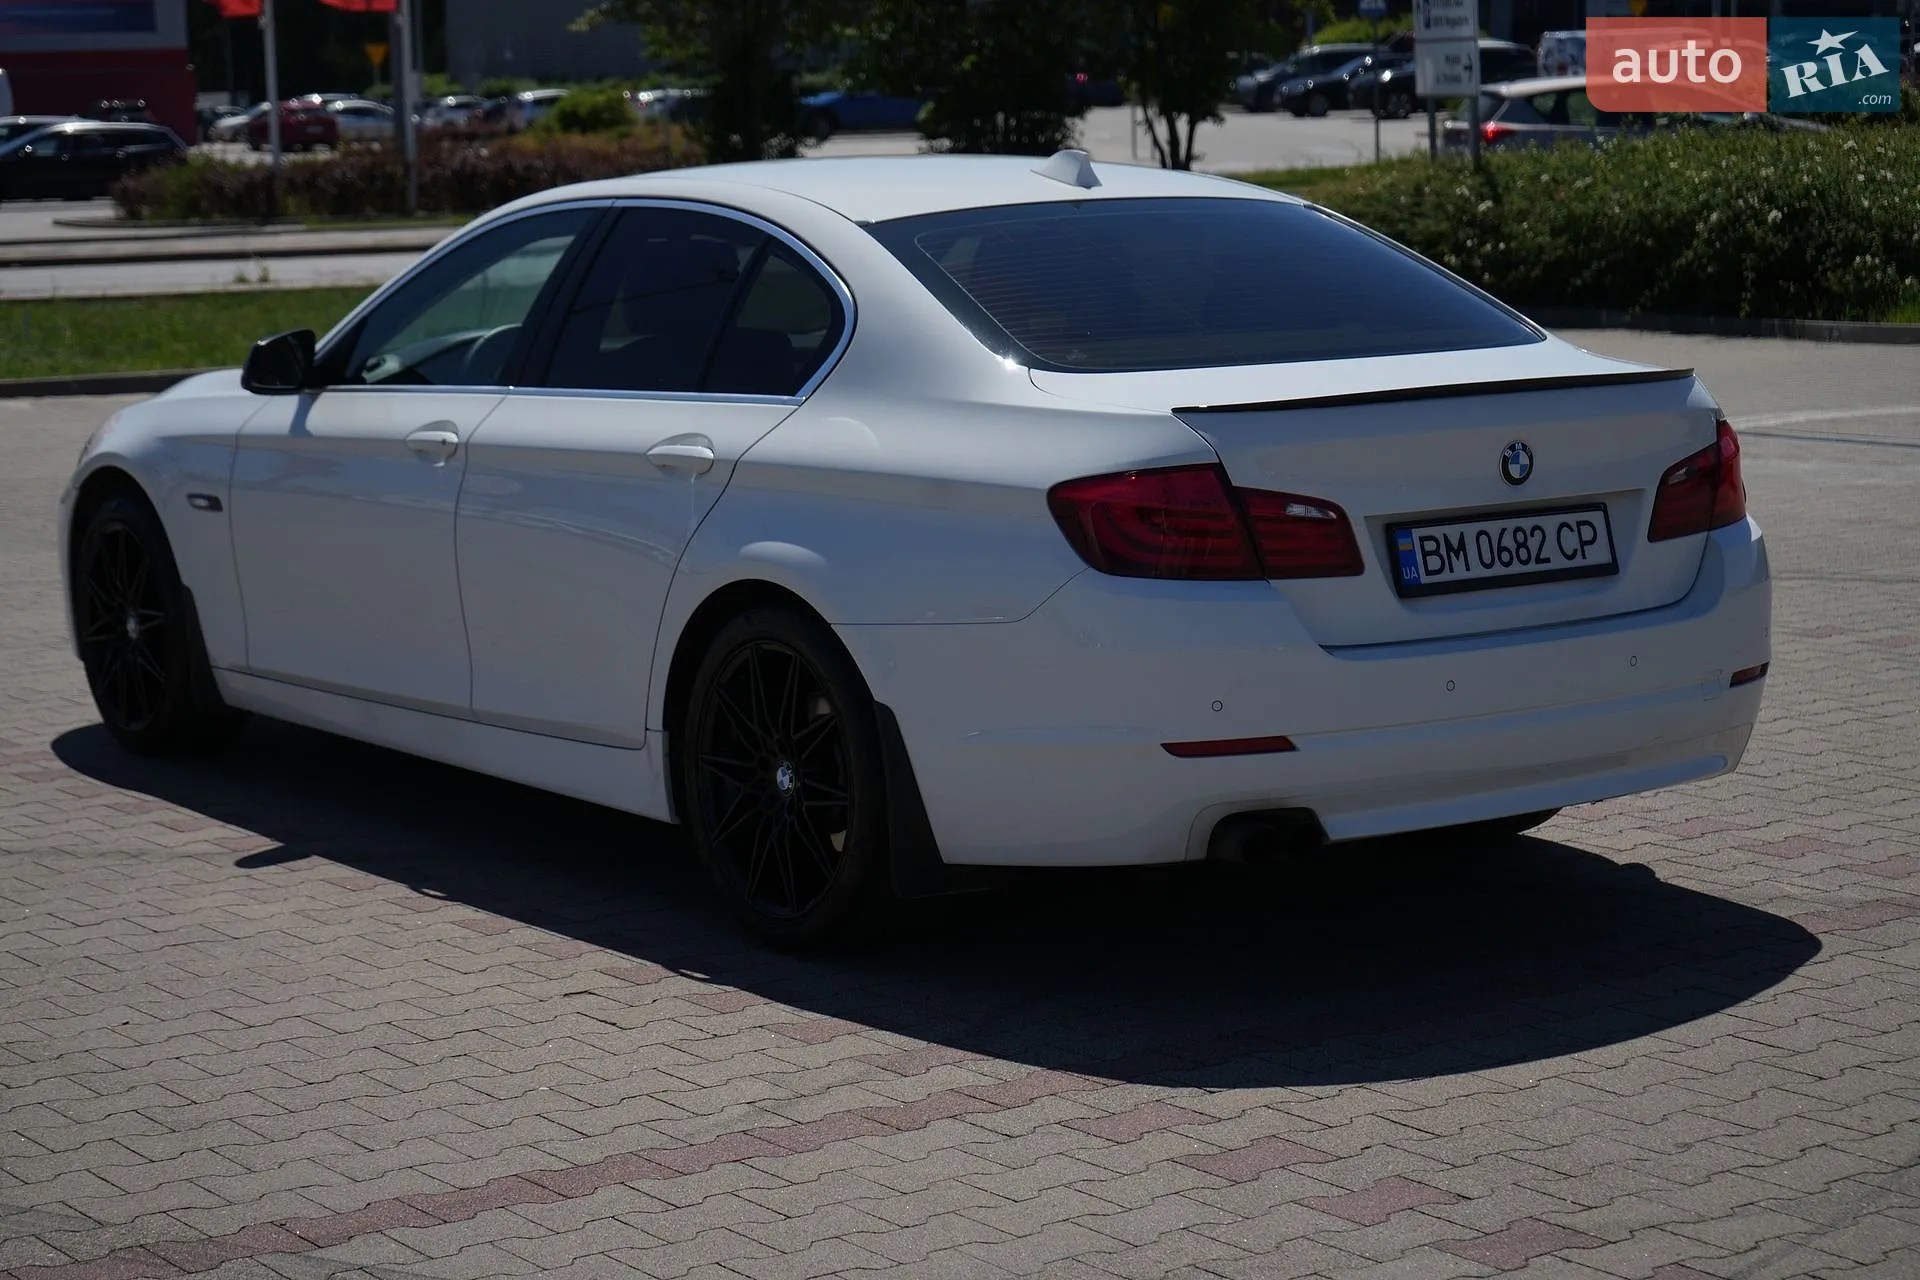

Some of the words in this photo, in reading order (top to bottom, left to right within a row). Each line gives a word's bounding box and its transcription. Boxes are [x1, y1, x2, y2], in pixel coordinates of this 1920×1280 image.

[1419, 532, 1470, 577] BM
[1475, 524, 1551, 570] 0682
[1556, 520, 1598, 560] CP
[1402, 567, 1419, 580] UA
